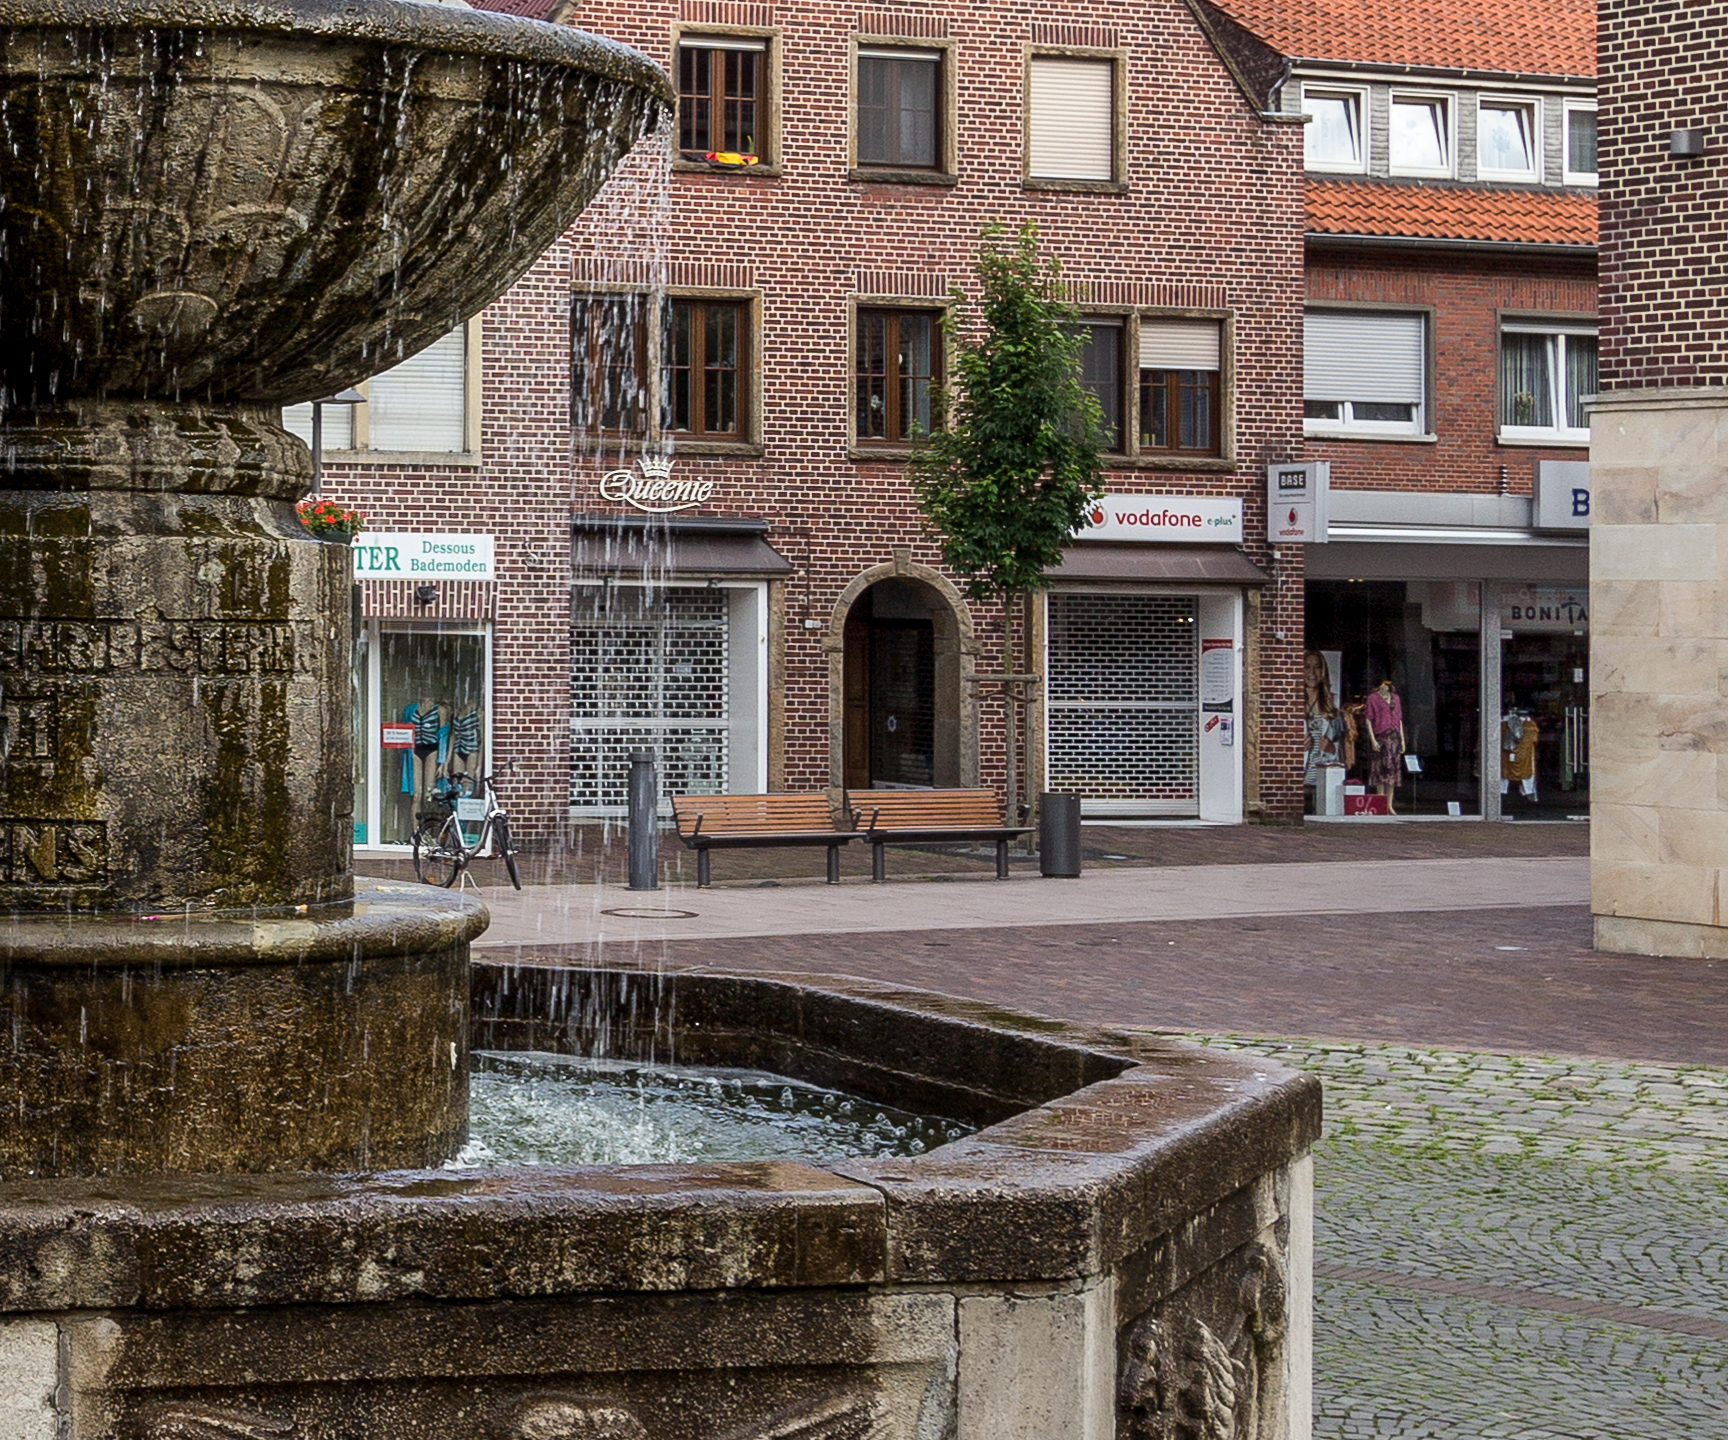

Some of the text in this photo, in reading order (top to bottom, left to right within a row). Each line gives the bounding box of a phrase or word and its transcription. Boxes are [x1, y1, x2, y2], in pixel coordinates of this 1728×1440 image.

[1280, 474, 1305, 487] BASE
[599, 469, 713, 513] Queenie
[1115, 509, 1203, 528] vodafone
[422, 540, 476, 554] Dessous
[410, 558, 487, 573] Bademoden
